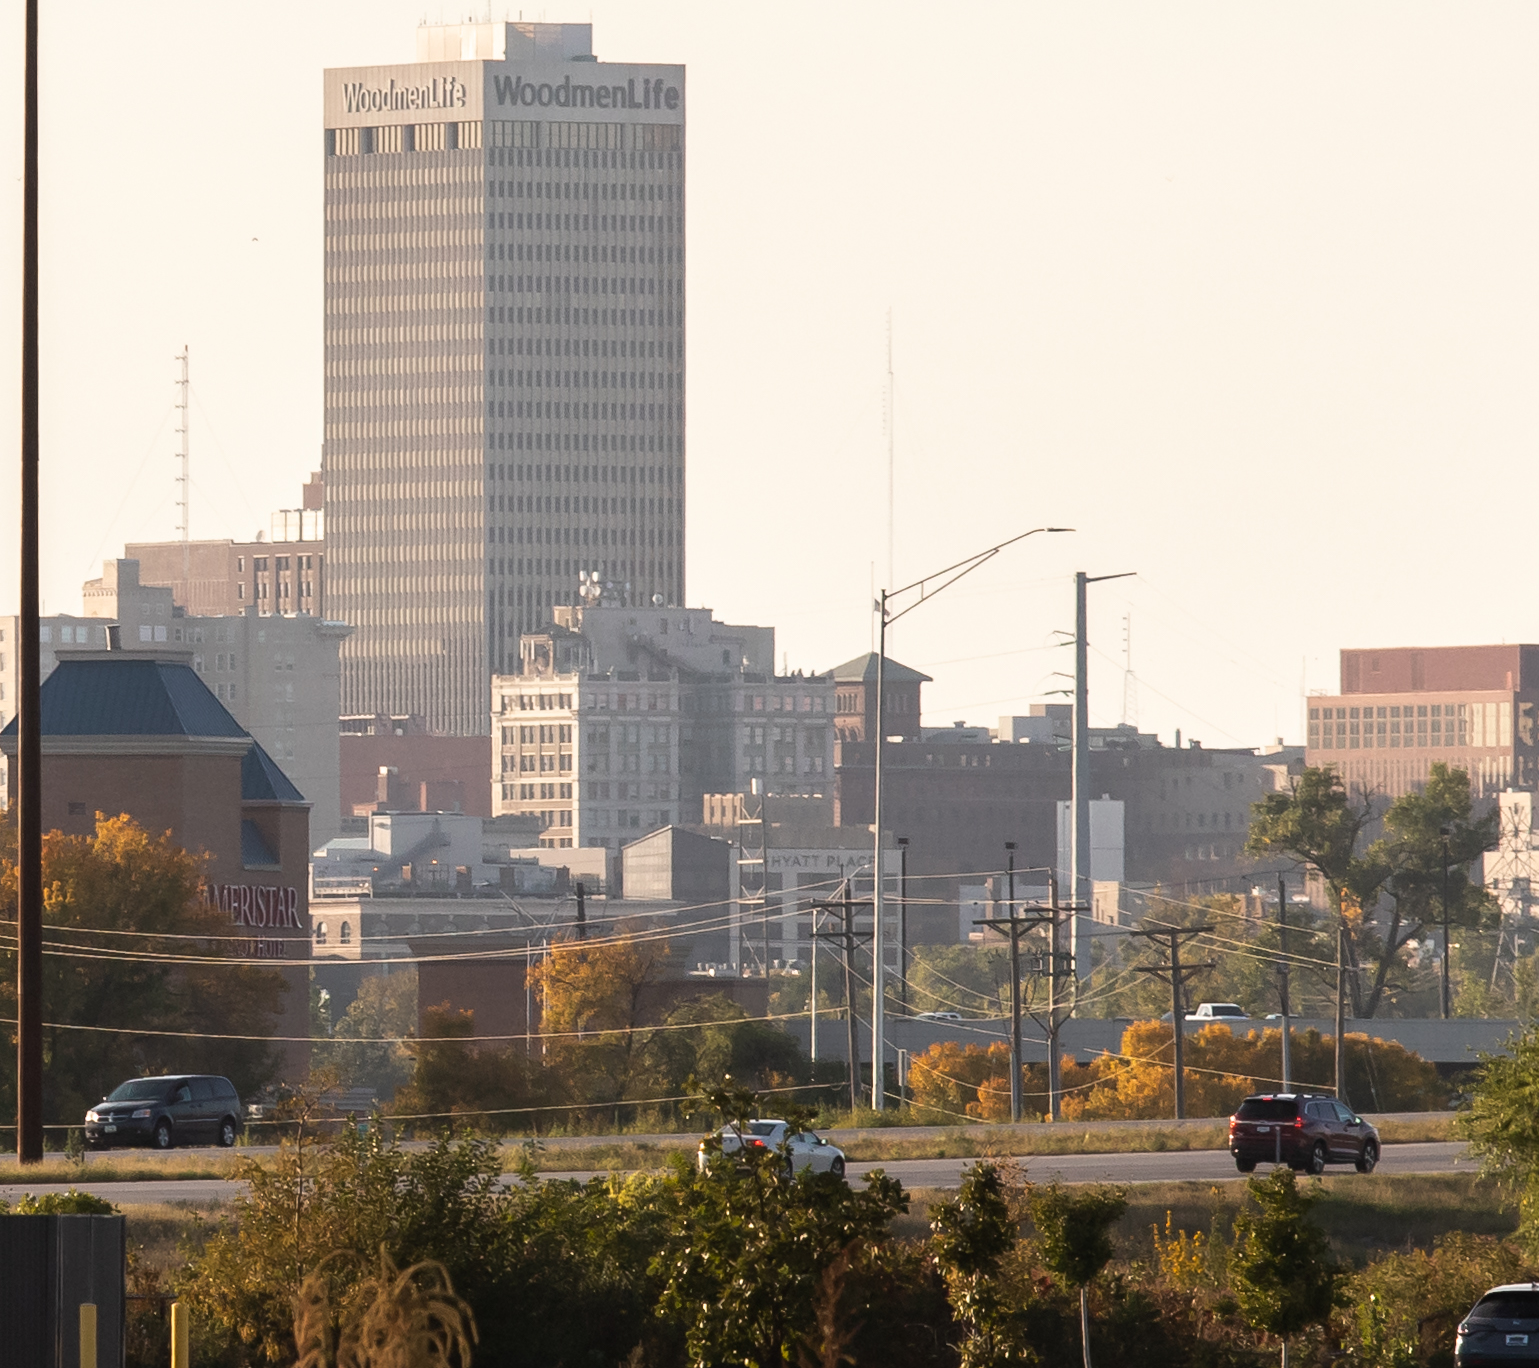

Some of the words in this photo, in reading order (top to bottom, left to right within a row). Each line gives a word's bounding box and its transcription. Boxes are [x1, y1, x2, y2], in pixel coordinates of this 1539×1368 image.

[342, 76, 467, 113] WoodmenLife
[493, 75, 680, 110] WoodmenLife
[772, 855, 819, 867] HYATT
